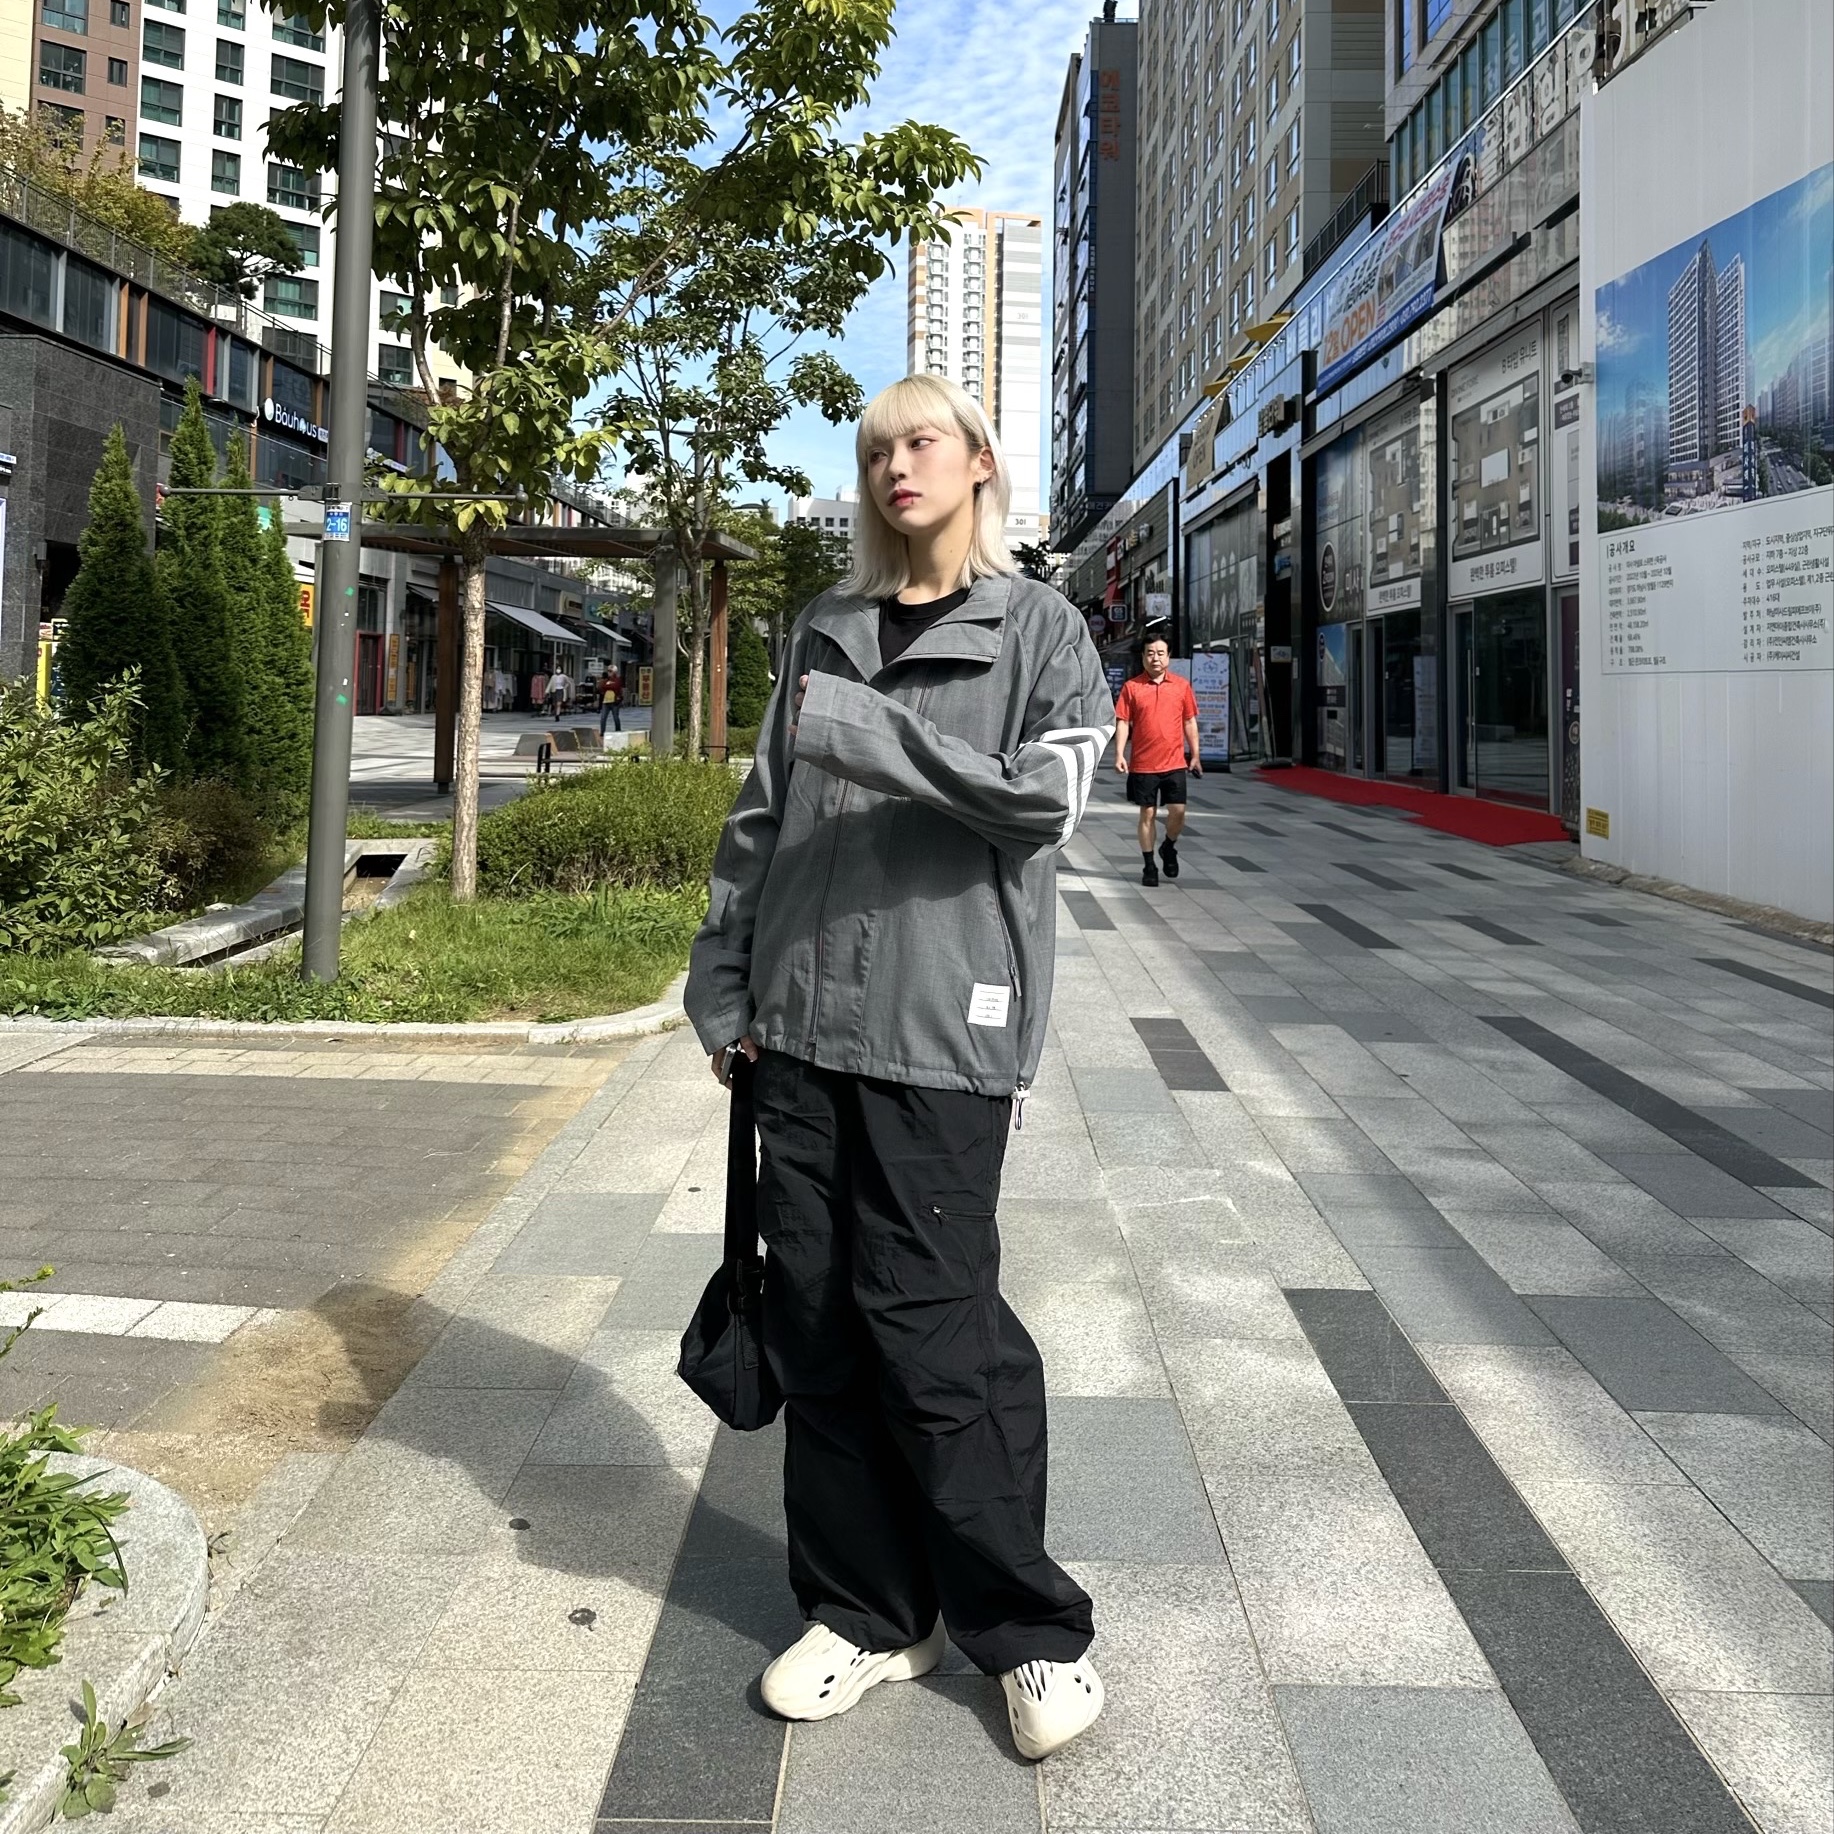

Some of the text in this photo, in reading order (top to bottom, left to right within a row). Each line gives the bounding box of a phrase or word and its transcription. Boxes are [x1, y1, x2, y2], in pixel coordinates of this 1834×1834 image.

[1340, 295, 1376, 352] OPEN
[326, 517, 348, 532] 2-16
[1015, 518, 1027, 526] 301
[1609, 540, 1635, 557] 공사개요
